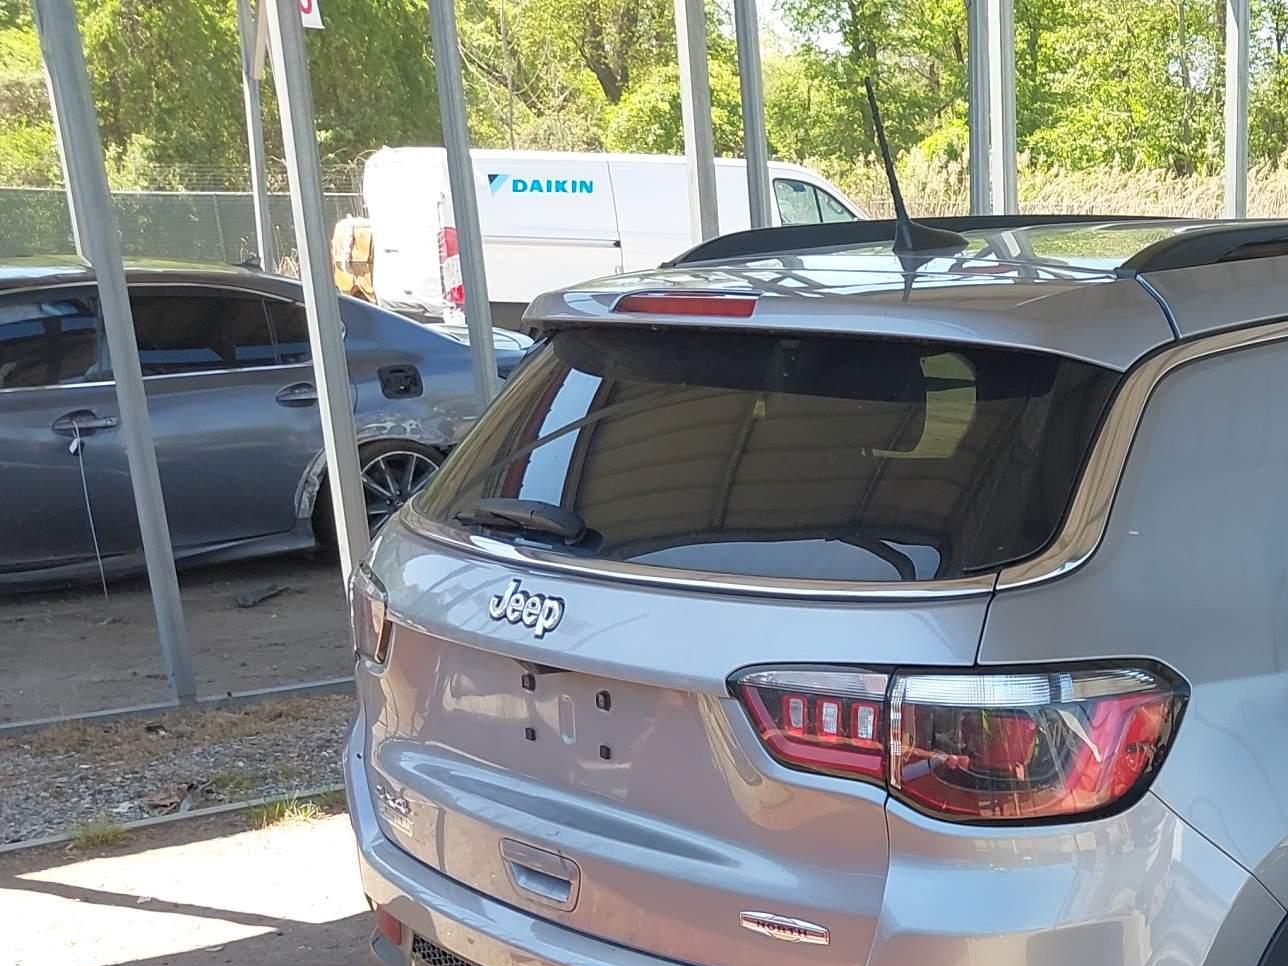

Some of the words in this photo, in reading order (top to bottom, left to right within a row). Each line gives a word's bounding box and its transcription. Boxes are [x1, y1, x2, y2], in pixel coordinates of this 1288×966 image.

[512, 178, 594, 194] DAIKIN
[489, 578, 565, 639] Jeep
[756, 919, 808, 936] NORTH
